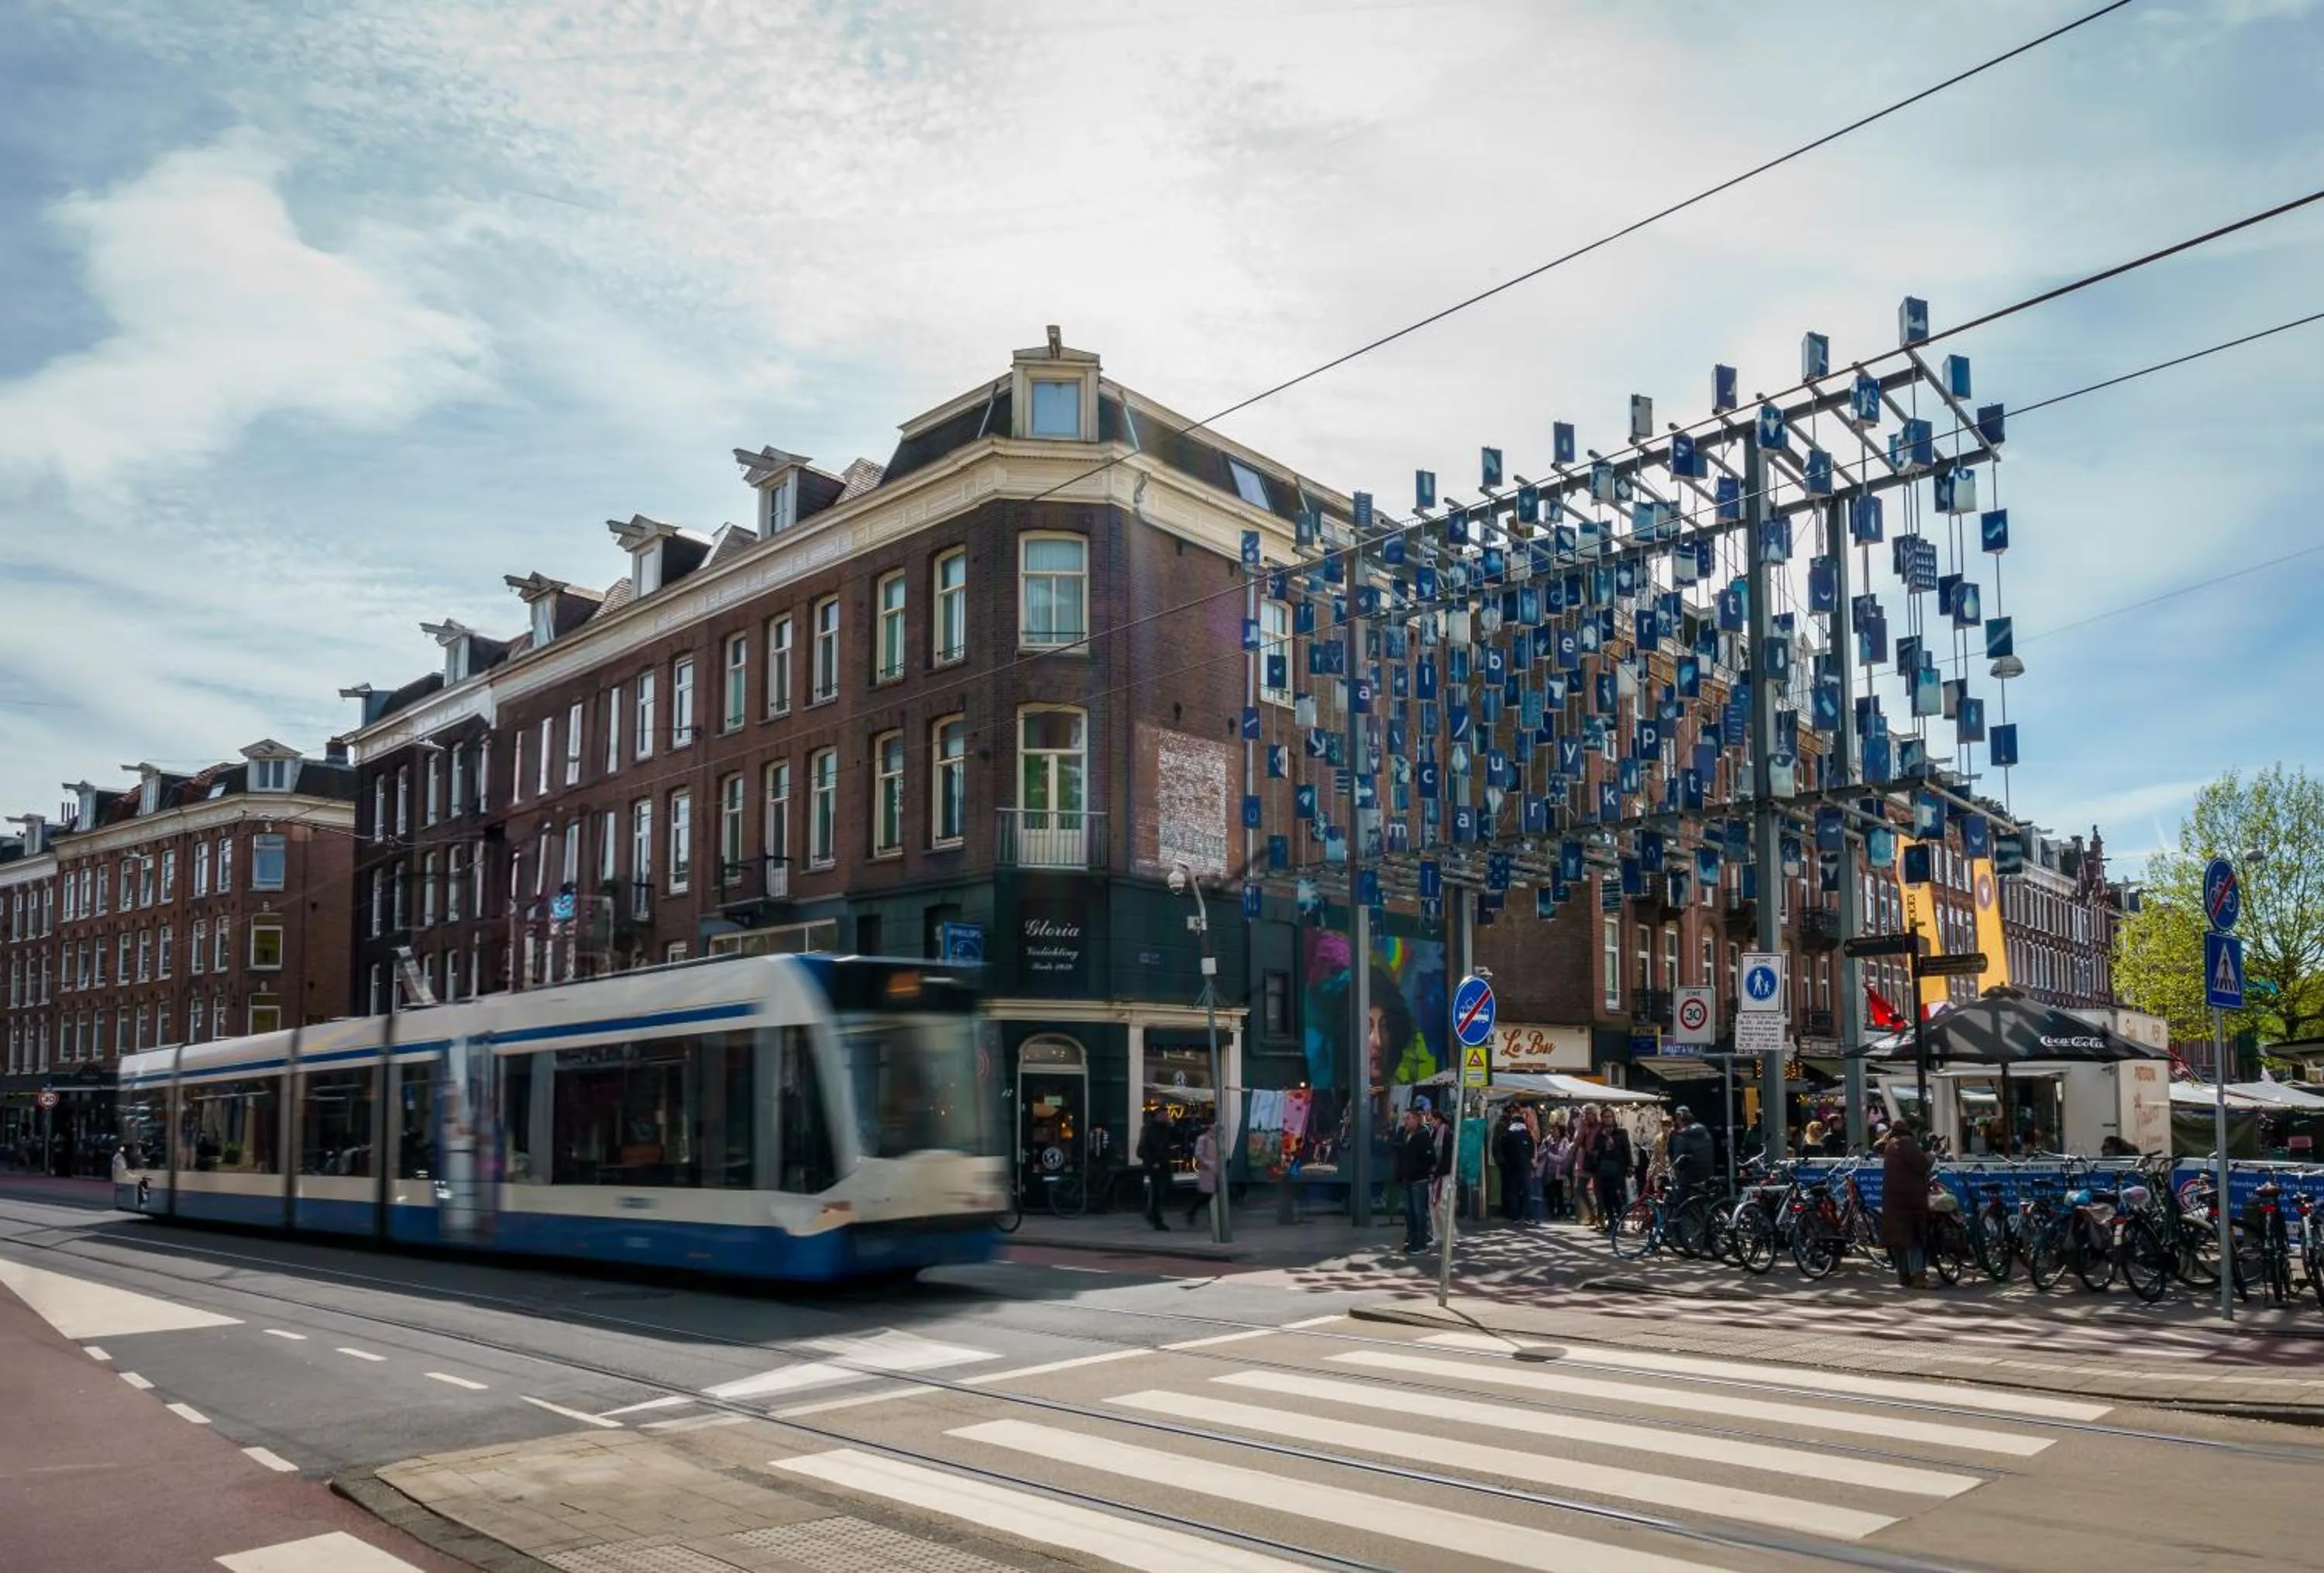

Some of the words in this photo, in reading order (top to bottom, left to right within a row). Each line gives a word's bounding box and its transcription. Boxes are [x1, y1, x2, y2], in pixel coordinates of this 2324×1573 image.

[1024, 918, 1080, 938] Gloria
[1685, 1007, 1703, 1021] 30
[2039, 1034, 2106, 1049] Coca-Cola
